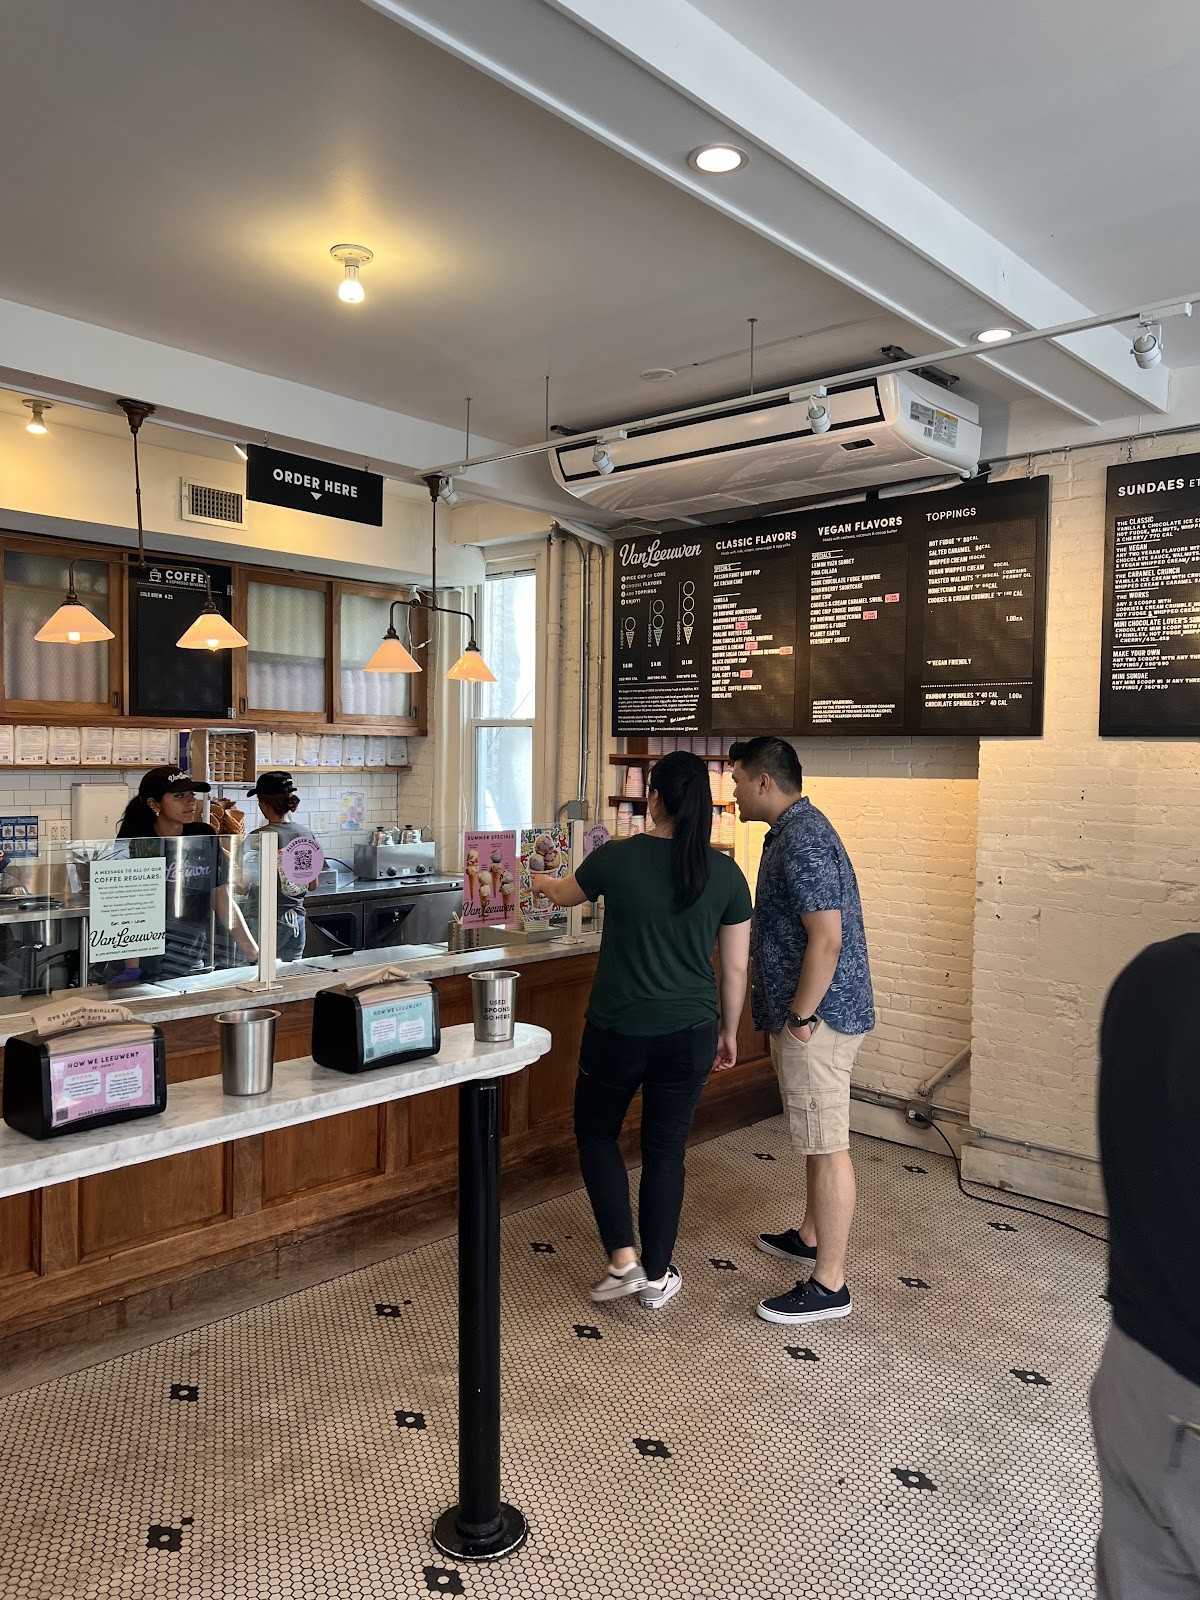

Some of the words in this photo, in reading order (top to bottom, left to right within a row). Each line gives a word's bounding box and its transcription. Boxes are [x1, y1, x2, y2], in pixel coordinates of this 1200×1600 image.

[273, 469, 320, 489] ORDER
[324, 480, 357, 498] HERE
[1118, 478, 1184, 496] SUNDAES
[926, 507, 976, 521] TOPPINGS
[1129, 516, 1154, 525] CLASSIC
[1148, 520, 1181, 528] CHOCOLATE
[818, 523, 852, 536] VEGAN
[855, 516, 903, 531] FLAVORS
[716, 537, 753, 550] CLASSIC
[755, 531, 797, 544] FLAVORS
[939, 538, 954, 546] FUDGE
[948, 546, 971, 554] CARAMEL
[929, 558, 949, 566] WHIPPED
[945, 566, 966, 574] WHIPPED
[1128, 570, 1155, 578] CARAMEL
[1157, 567, 1180, 575] CRUNCH
[928, 577, 949, 585] TOASTED
[928, 586, 956, 594] HONEYCOMB
[958, 584, 973, 592] CANDY
[928, 596, 947, 604] COOKIES
[971, 592, 994, 600] CRUMBLE
[1129, 591, 1150, 599] WORKS
[1114, 620, 1127, 628] MINI
[1128, 619, 1161, 627] CHOCOLATE
[287, 839, 307, 852] ALLERGEN
[101, 1052, 139, 1062] LEEUWEN?
